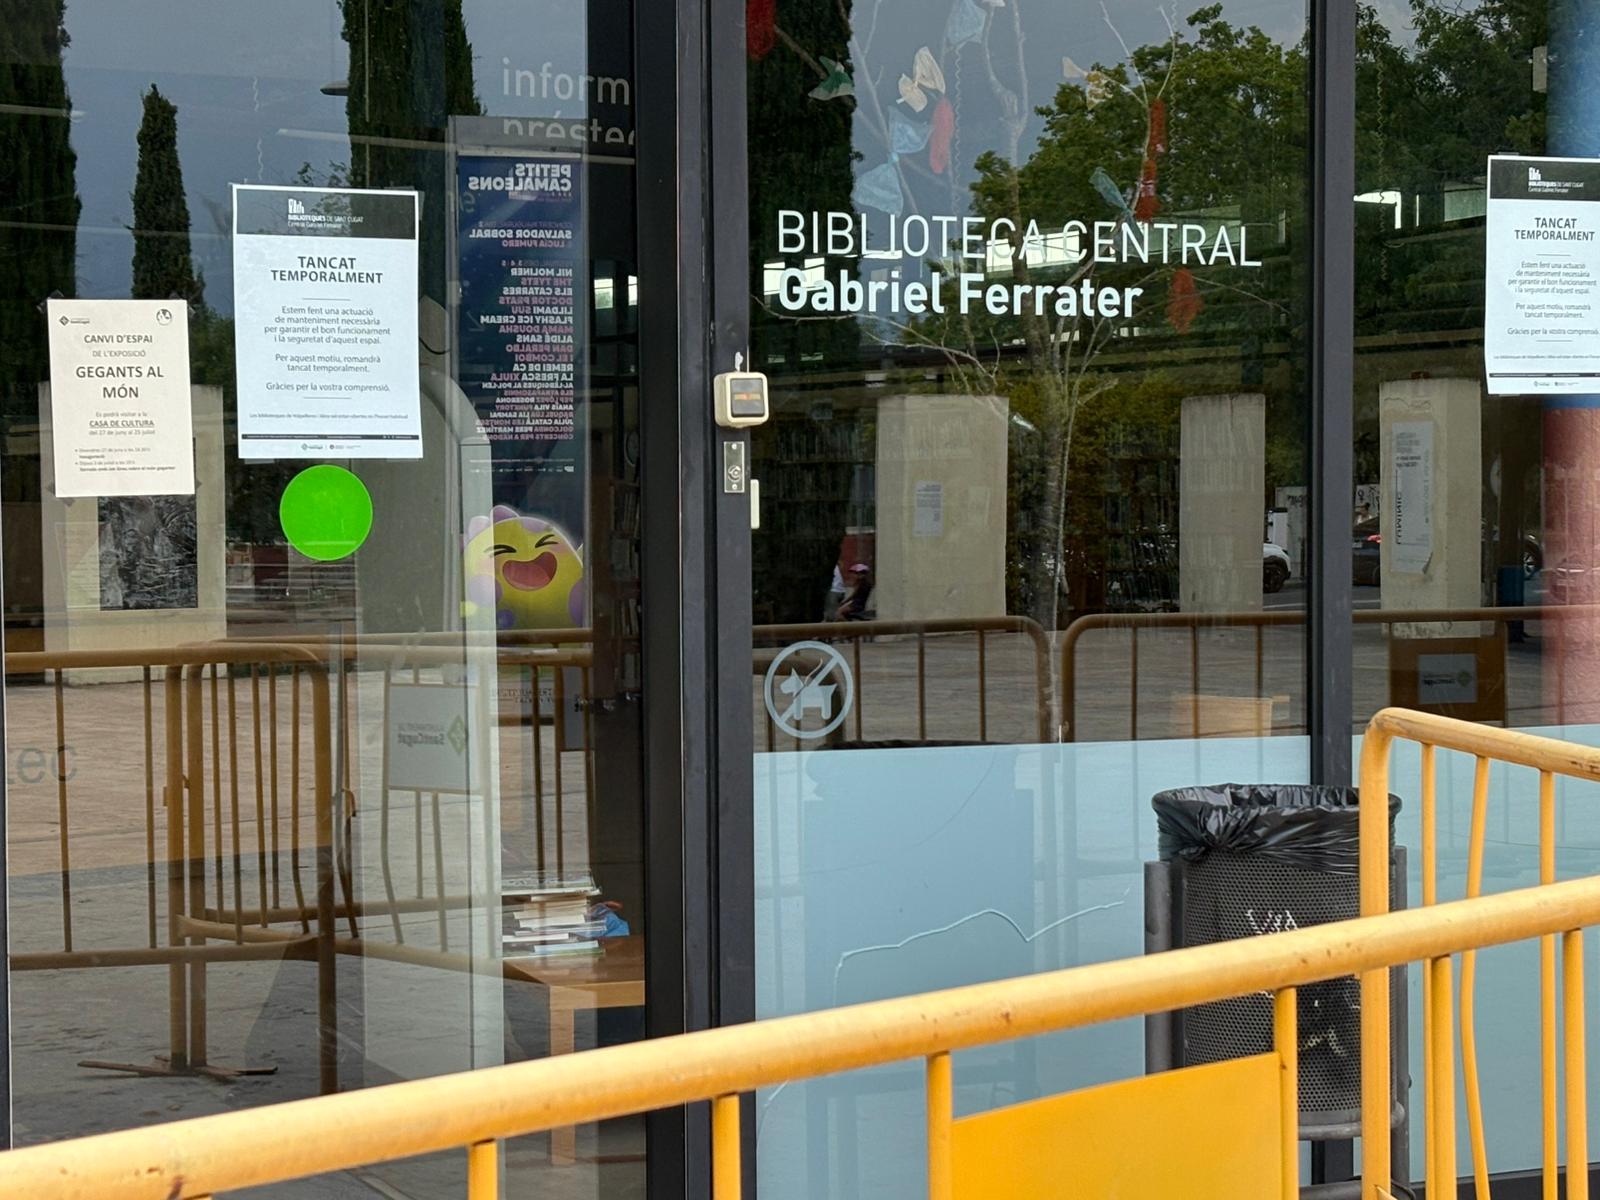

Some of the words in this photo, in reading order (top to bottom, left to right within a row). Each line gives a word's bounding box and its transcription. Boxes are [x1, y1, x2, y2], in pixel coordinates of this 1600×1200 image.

[1535, 218, 1577, 229] TANCAT
[778, 209, 1050, 265] BIBLIOTECA
[1062, 219, 1264, 267] CENTRAL
[1515, 230, 1595, 241] TEMPORALMENT
[298, 256, 356, 269] TANCAT
[271, 270, 383, 283] TEMPORALMENT
[778, 267, 945, 314] Gabriel
[959, 272, 1144, 318] Ferrater
[282, 306, 306, 314] Estem
[308, 306, 323, 314] fent
[341, 307, 374, 316] actuació
[287, 316, 340, 325] manteniment
[341, 317, 381, 325] necessària
[264, 326, 277, 334] per
[279, 326, 310, 334] garantir
[312, 326, 319, 334] el
[321, 326, 336, 334] bon
[337, 327, 391, 336] funcionament
[84, 335, 114, 343] CANVI
[117, 335, 152, 343] D'ESPAI
[288, 335, 324, 344] seguretat
[325, 336, 358, 345] d'aquest
[360, 337, 382, 346] espai.
[275, 353, 288, 361] Per
[290, 354, 315, 363] aquest
[317, 354, 343, 363] motiu,
[344, 355, 381, 363] romandrà
[76, 366, 143, 378] GEGANTS
[147, 366, 164, 378] AL
[287, 363, 311, 371] tancat
[313, 363, 371, 373] temporalment.
[103, 383, 139, 399] MÓN
[266, 382, 294, 391] Gràcies
[296, 384, 309, 392] per
[311, 382, 318, 390] la
[344, 384, 391, 392] comprensió.
[90, 420, 108, 428] CASA
[110, 420, 119, 428] DE
[121, 420, 155, 428] CULTURA
[7, 744, 79, 785] ec
